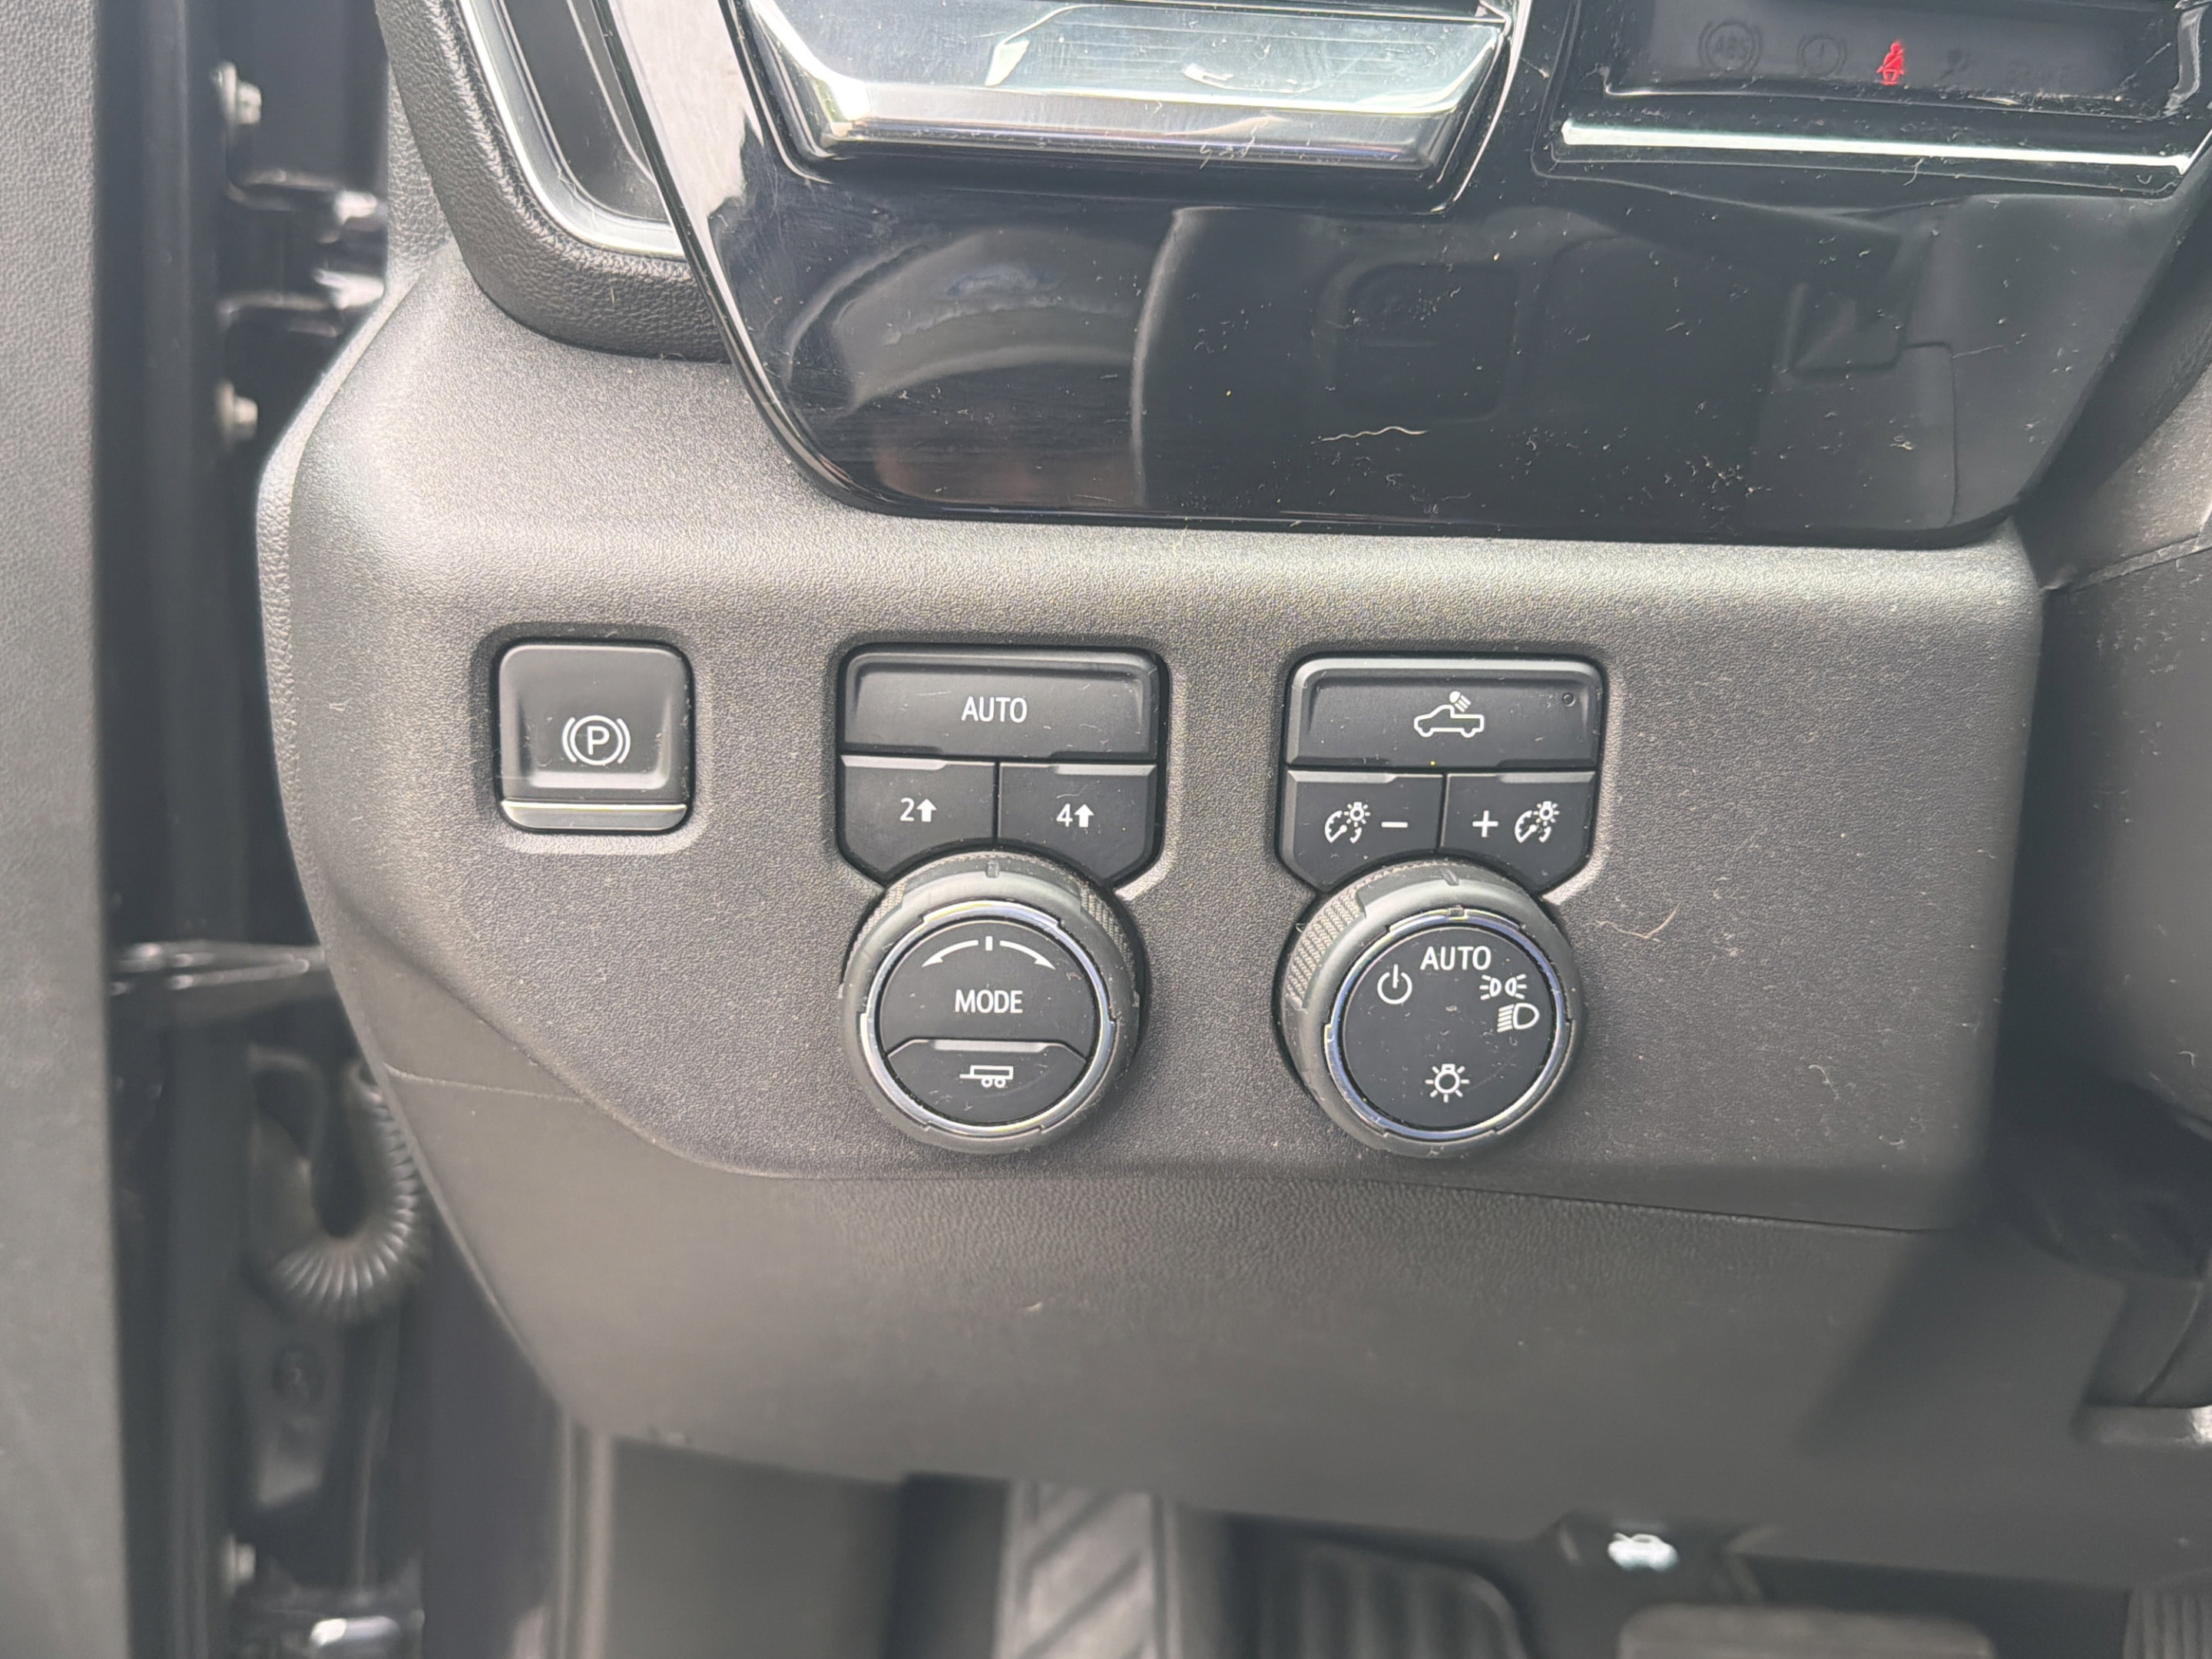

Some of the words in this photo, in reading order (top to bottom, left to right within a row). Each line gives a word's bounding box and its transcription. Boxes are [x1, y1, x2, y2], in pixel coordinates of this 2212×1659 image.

[961, 696, 1027, 723] AUTO
[587, 726, 610, 756] P
[1419, 945, 1492, 971] AUTO
[955, 988, 1024, 1014] MODE
